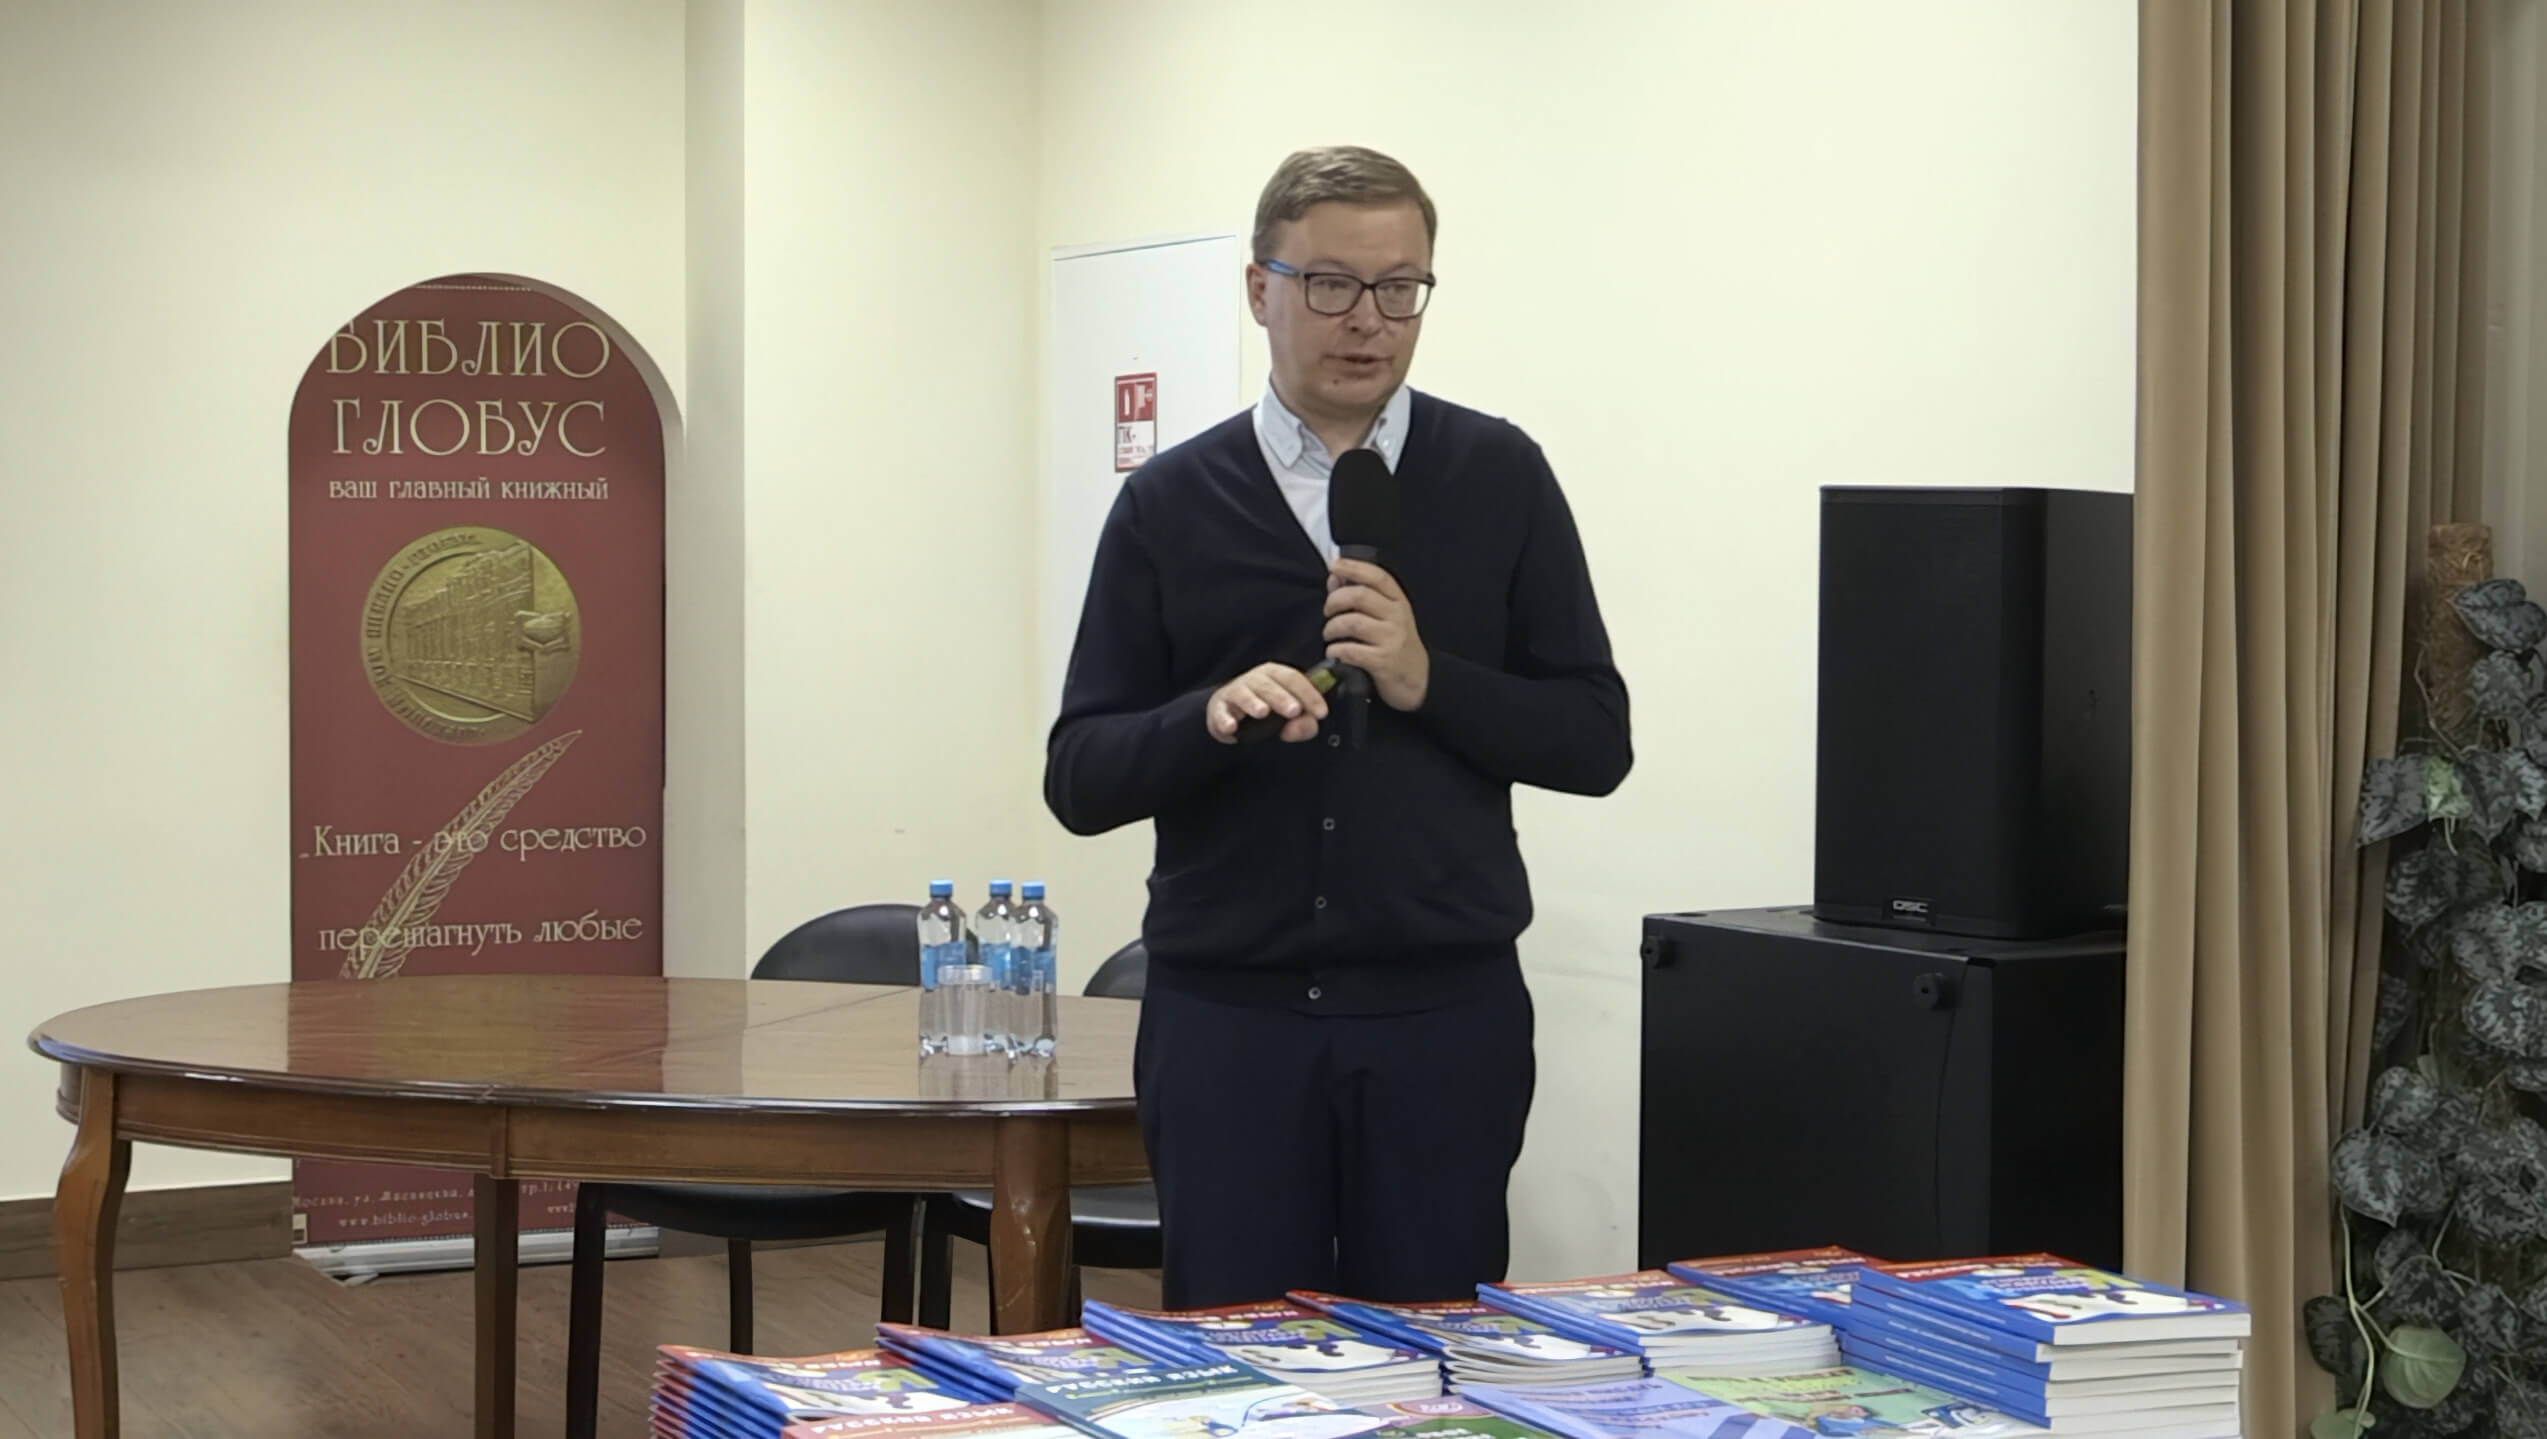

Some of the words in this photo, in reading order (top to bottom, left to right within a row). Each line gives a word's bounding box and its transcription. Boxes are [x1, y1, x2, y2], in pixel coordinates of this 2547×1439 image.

[326, 319, 611, 378] БИБЛИО
[332, 397, 606, 457] ГЛОБУС
[329, 481, 378, 498] ваш
[389, 477, 490, 499] главный
[501, 477, 609, 499] книжный
[314, 825, 400, 856] Книга
[434, 830, 489, 853] это
[500, 826, 646, 862] средство
[319, 920, 522, 960] перешагнуть
[534, 909, 643, 942] любые
